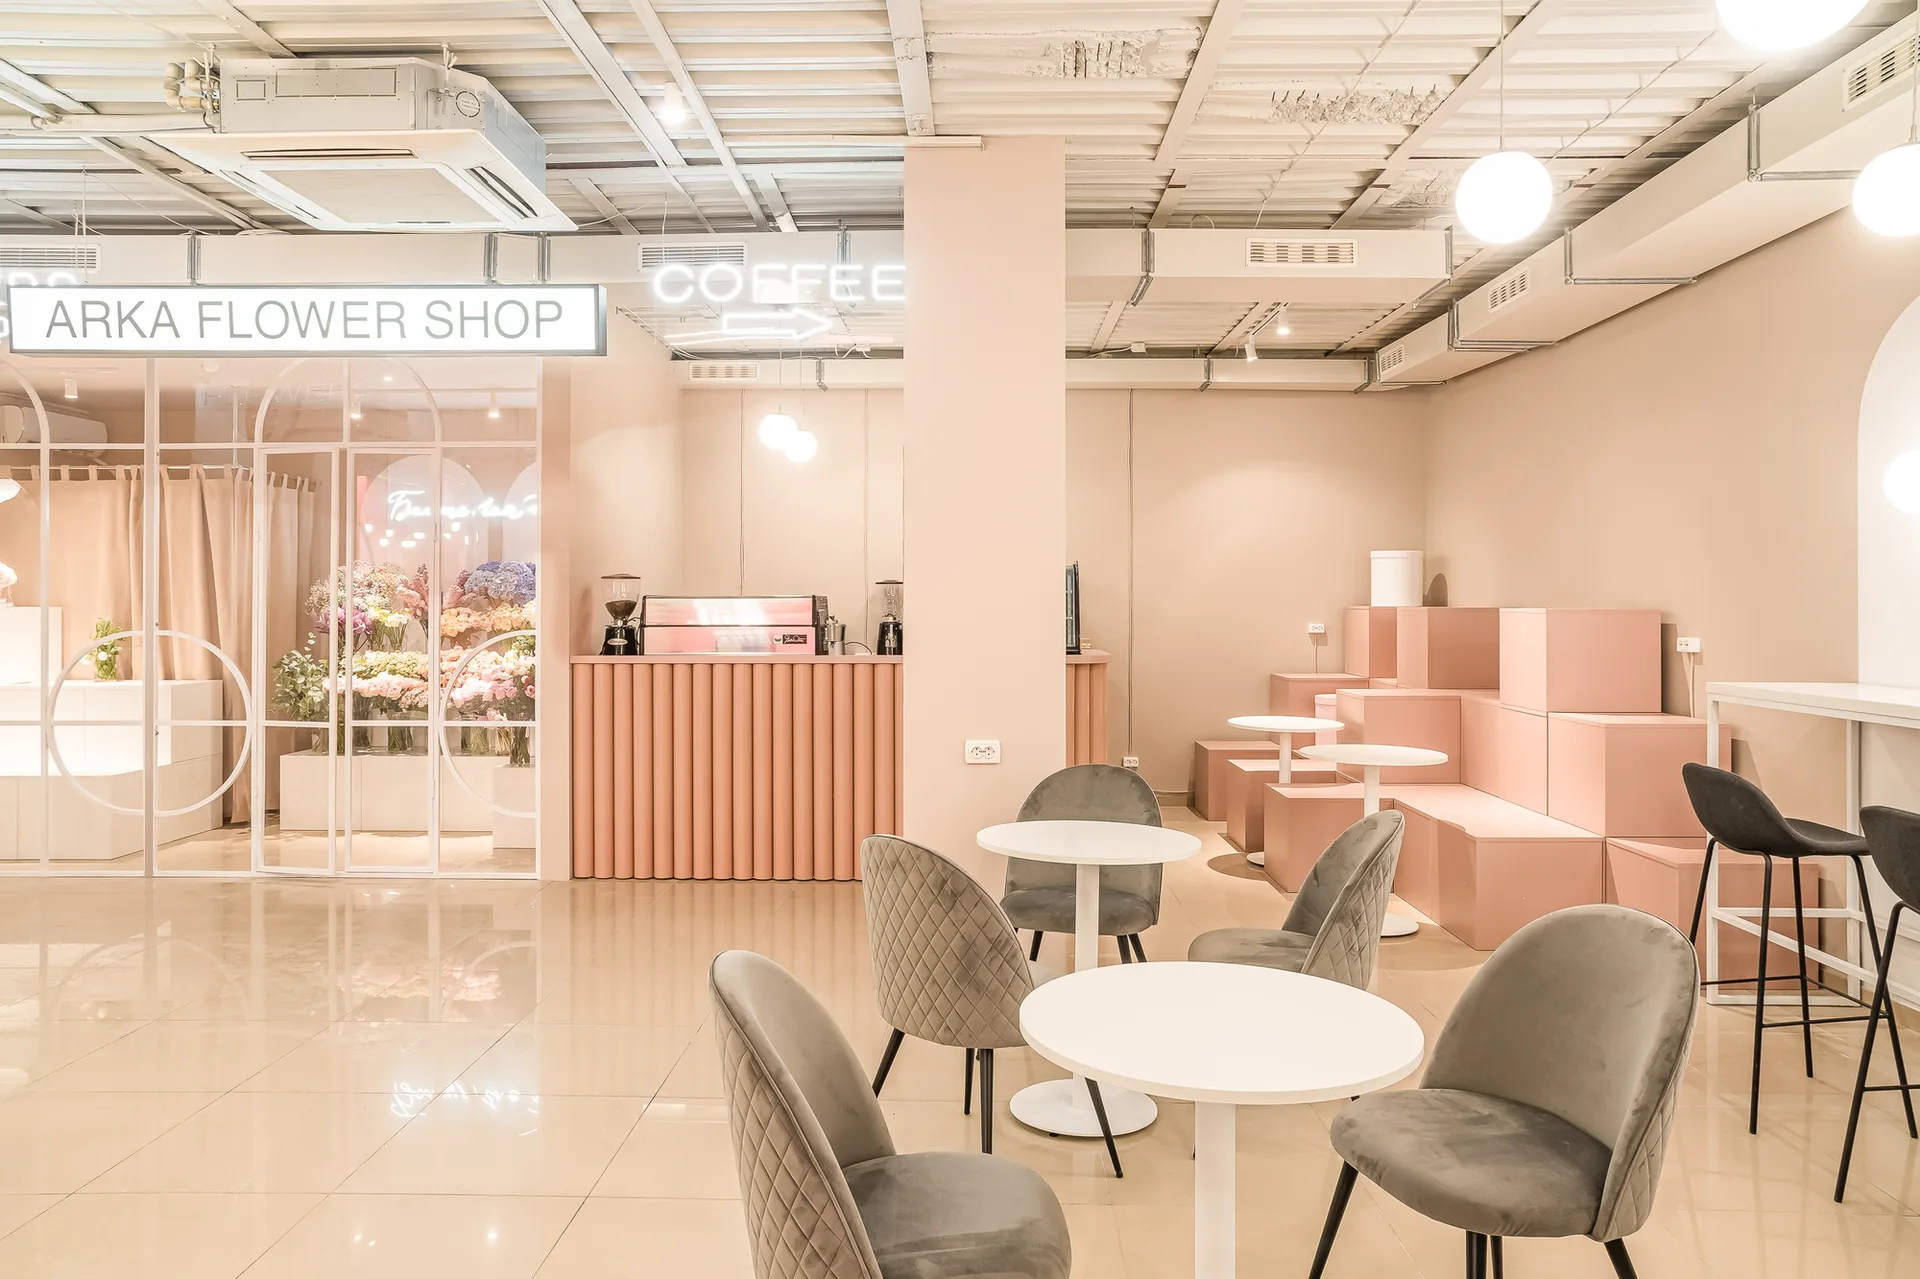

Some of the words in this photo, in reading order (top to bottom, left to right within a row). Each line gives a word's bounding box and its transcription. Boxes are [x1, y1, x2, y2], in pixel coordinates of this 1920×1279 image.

[652, 263, 906, 303] COFFEE
[46, 300, 180, 338] ARKA
[199, 300, 406, 339] FLOWER
[426, 300, 562, 339] SHOP
